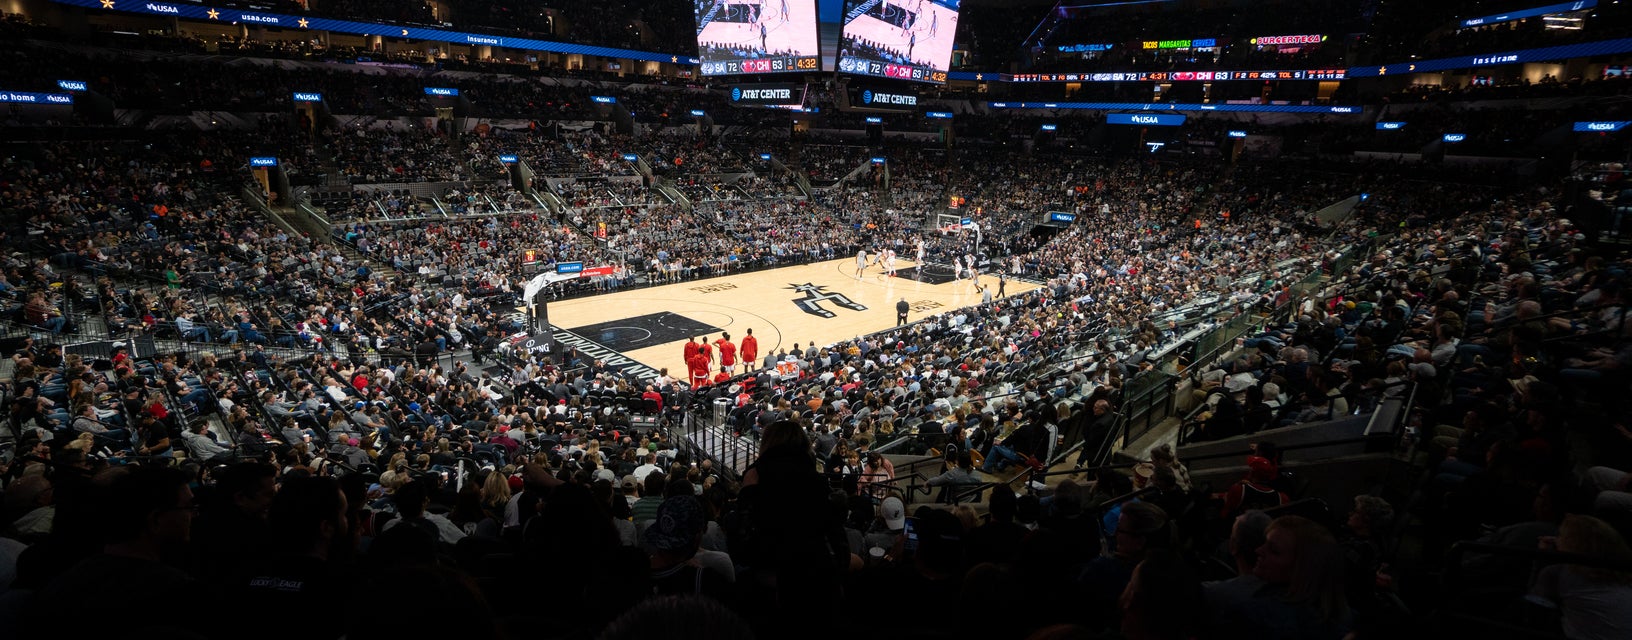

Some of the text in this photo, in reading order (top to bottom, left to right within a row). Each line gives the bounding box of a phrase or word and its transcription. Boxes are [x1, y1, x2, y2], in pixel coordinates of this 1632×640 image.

[157, 5, 179, 14] USAA
[241, 14, 279, 23] usaa.com
[467, 35, 498, 45] Insurance
[1142, 41, 1158, 49] TACOS
[1158, 40, 1192, 49] MARGARITAS
[1257, 35, 1320, 45] BURGERTECA
[715, 63, 725, 72] SA
[727, 62, 738, 72] 72
[756, 60, 770, 71] CHI
[772, 60, 783, 70] 63
[797, 58, 816, 69] 4:32
[857, 62, 867, 72] SA
[870, 64, 881, 74] 72
[899, 67, 911, 78] CHI
[912, 69, 922, 79] 63
[931, 71, 947, 82] 4:32
[1112, 73, 1123, 81] SA
[1125, 73, 1137, 81] 72
[1215, 72, 1229, 80] 63
[67, 82, 85, 90] USAA
[10, 93, 36, 102] home
[741, 88, 791, 99] AT&T CENTER
[54, 95, 71, 103] USAA
[873, 93, 917, 105] AT&T CENTER
[1140, 116, 1159, 124] USAA
